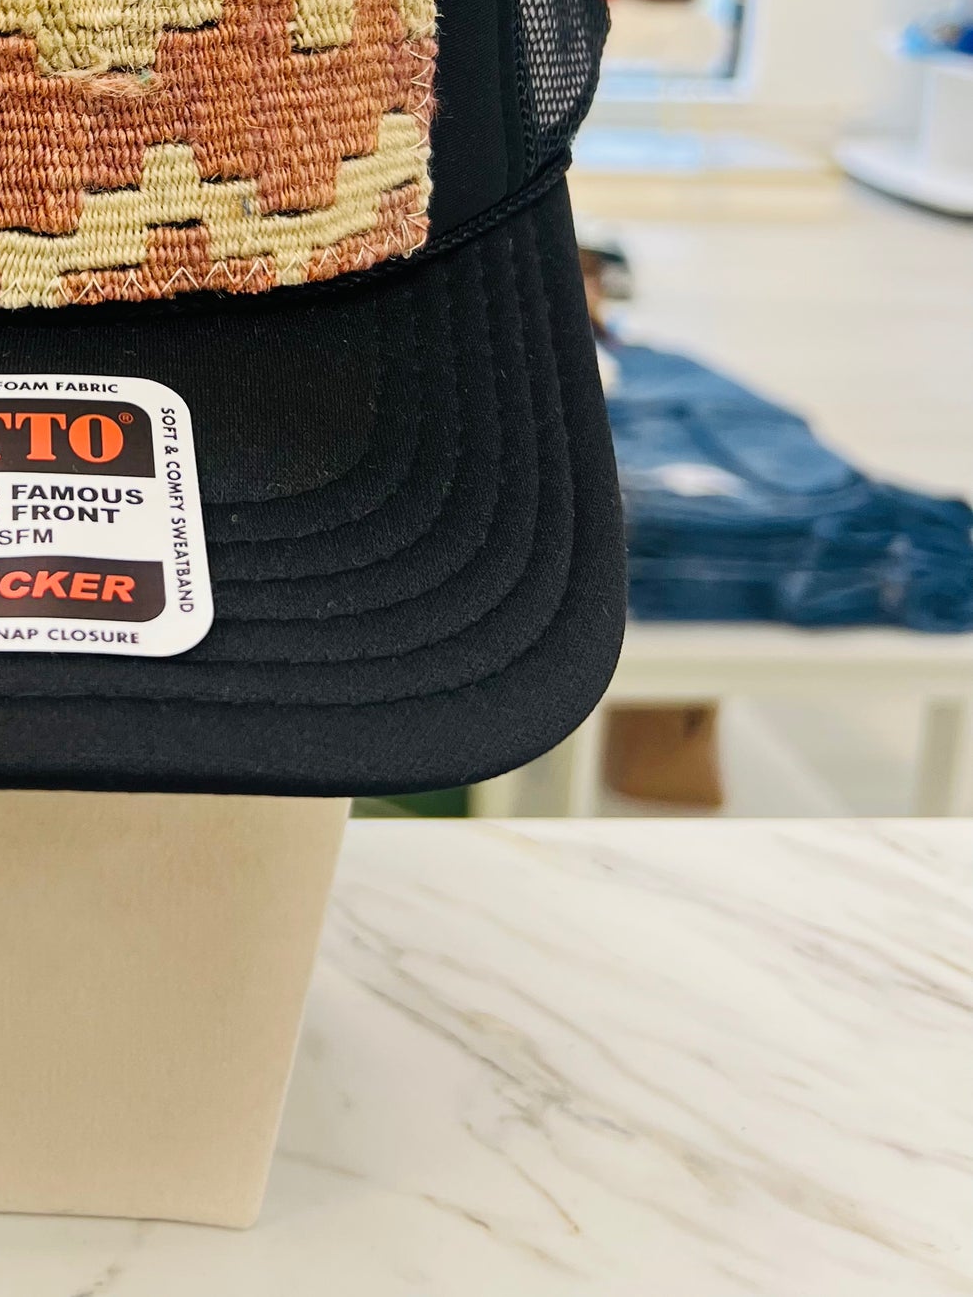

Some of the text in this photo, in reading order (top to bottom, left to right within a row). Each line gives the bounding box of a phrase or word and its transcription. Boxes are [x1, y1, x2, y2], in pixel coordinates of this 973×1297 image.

[56, 382, 118, 394] FABRIC
[12, 485, 144, 505] FAMOUS
[12, 506, 120, 523] FRONT
[161, 408, 194, 612] SOFT & COMFY SWEATBAND
[48, 629, 139, 644] CLOSURE
